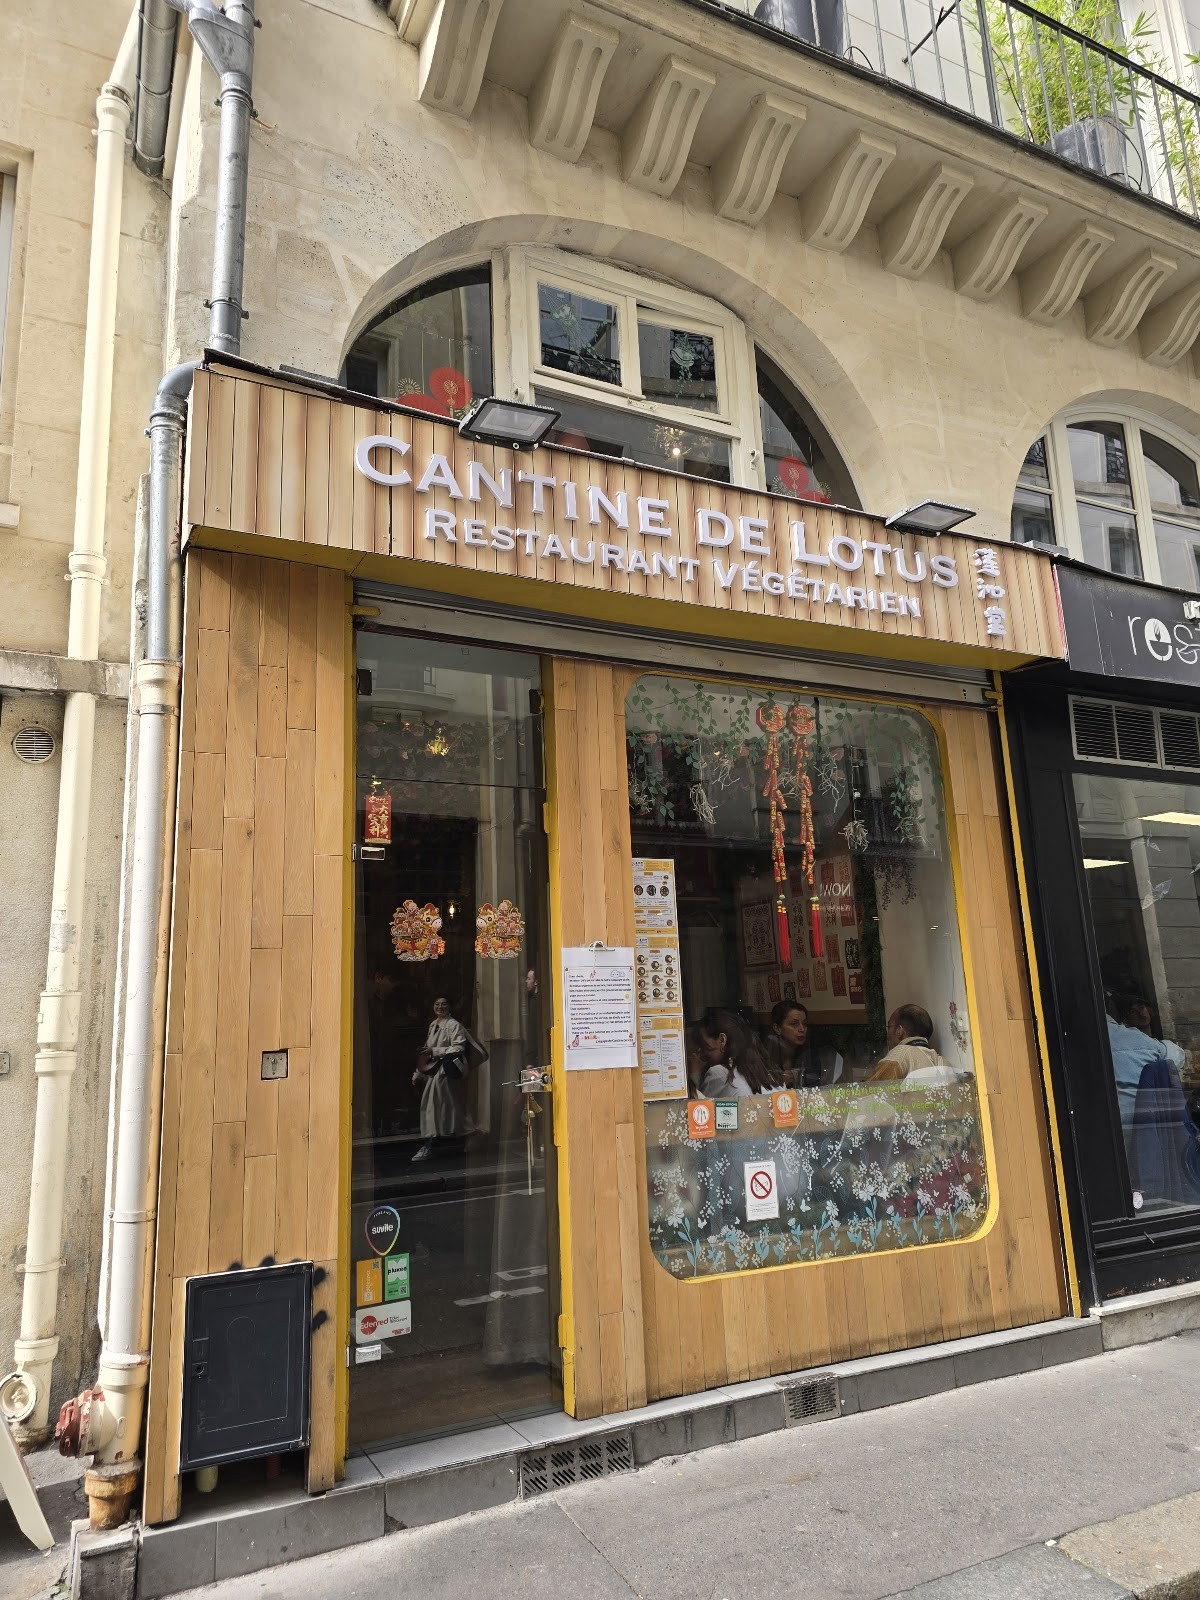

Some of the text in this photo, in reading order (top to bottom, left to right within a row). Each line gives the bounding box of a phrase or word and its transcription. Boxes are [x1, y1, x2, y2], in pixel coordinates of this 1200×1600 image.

[355, 434, 959, 590] CANTINE DE LOTUS
[425, 507, 920, 618] RESTAURANT VÉGÉTARIEN
[1127, 615, 1200, 665] res
[371, 1223, 394, 1235] swile
